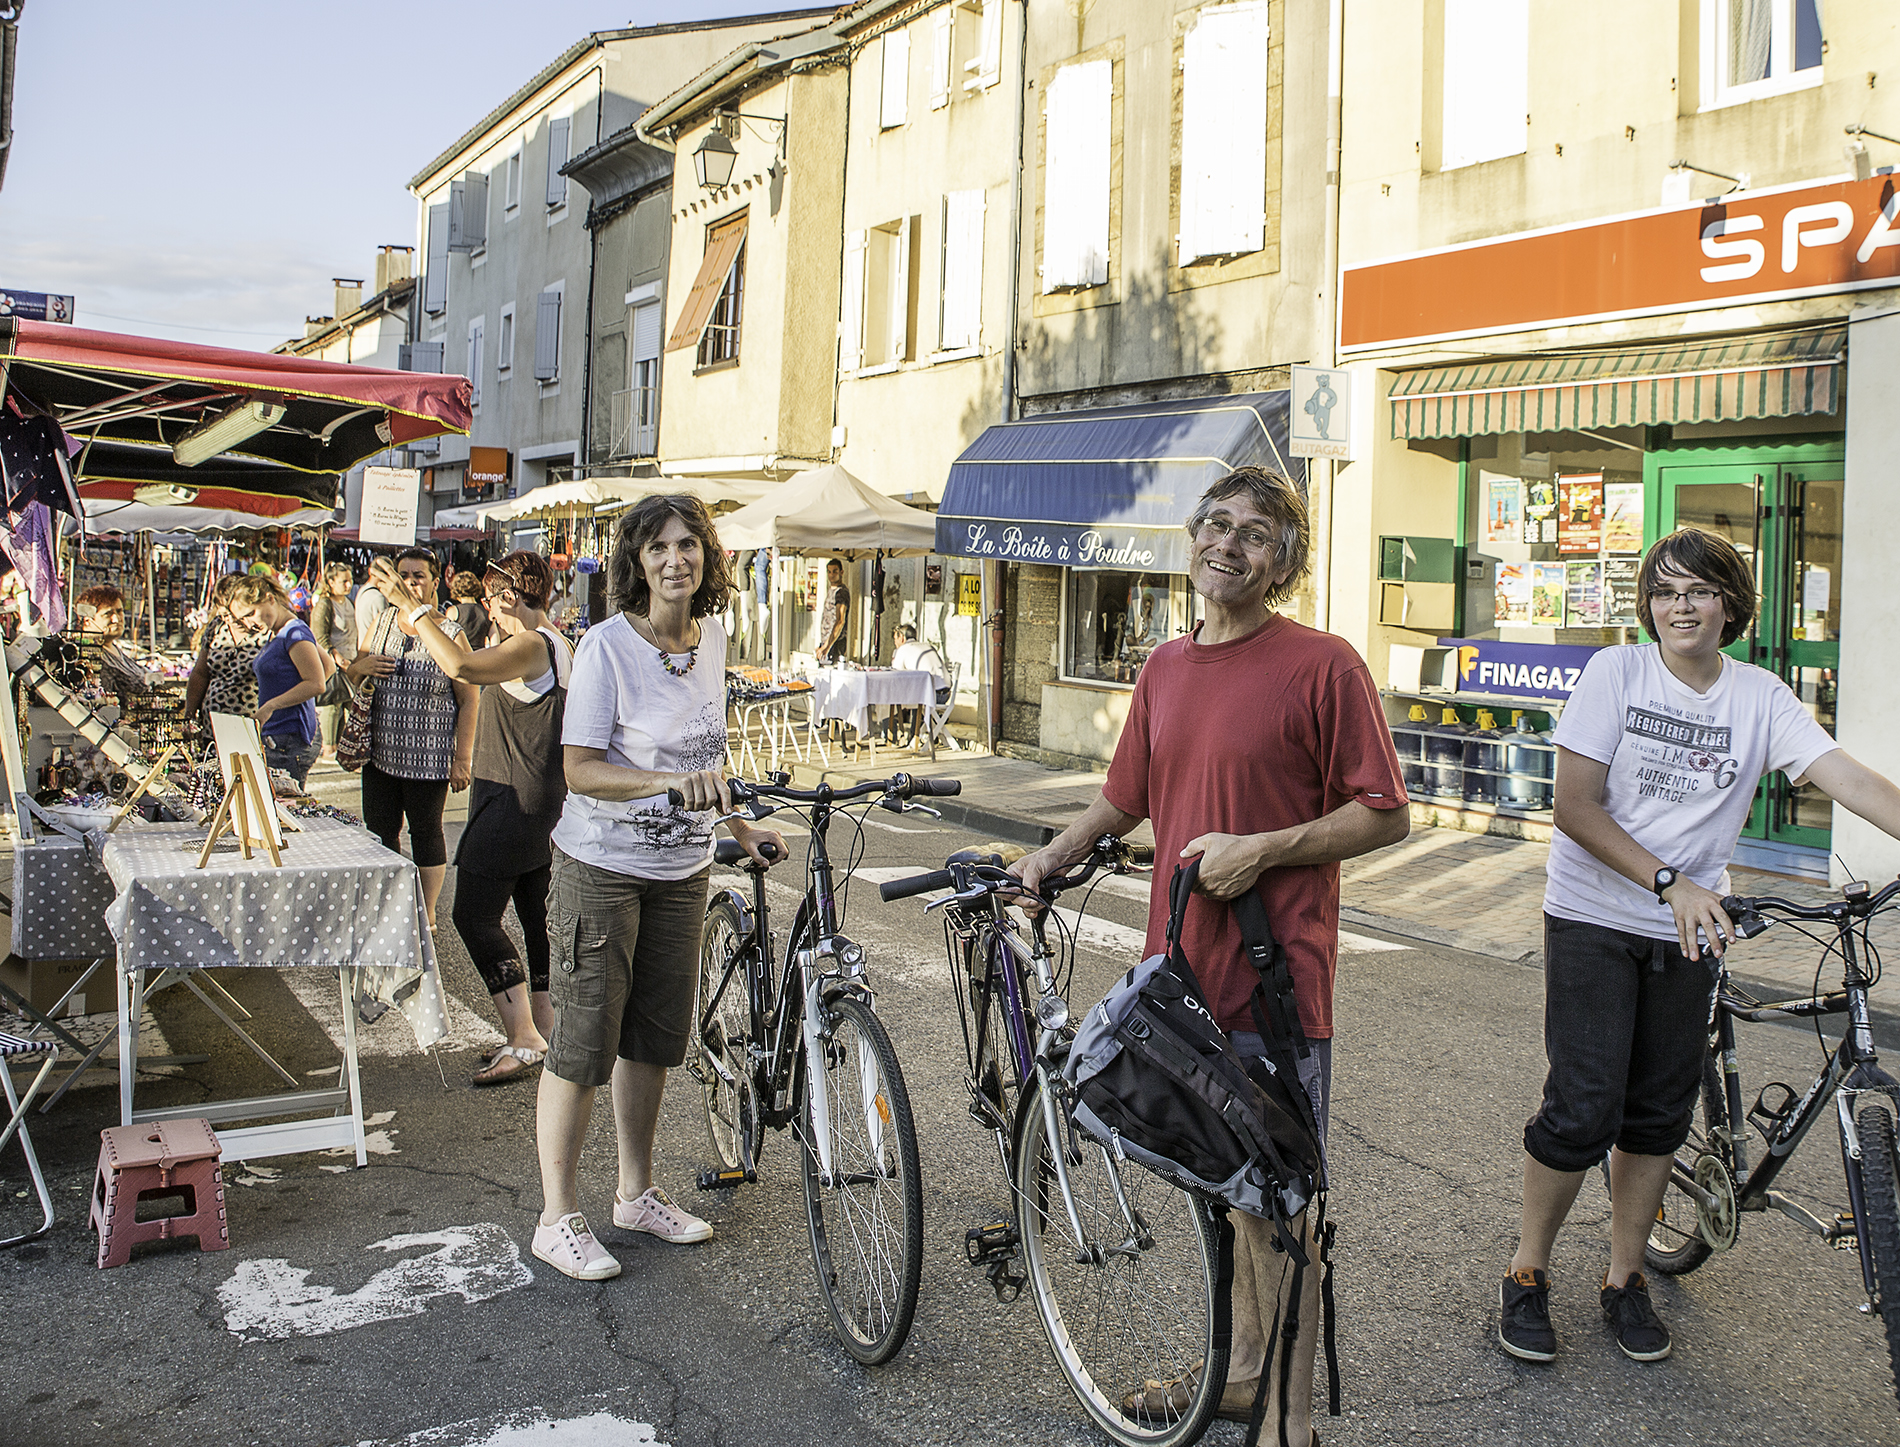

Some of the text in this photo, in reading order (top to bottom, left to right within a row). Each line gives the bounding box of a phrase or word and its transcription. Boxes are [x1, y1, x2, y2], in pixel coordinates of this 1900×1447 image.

[1291, 442, 1347, 456] BUTAGAZ
[472, 472, 504, 483] orange
[965, 524, 1155, 566] La Boîte à Poudre
[964, 580, 969, 594] A
[1479, 661, 1581, 692] FINAGAZ
[1649, 700, 1716, 724] PREMIUM QUALITY
[1626, 711, 1729, 748] REGISTERED LABEL
[1630, 742, 1659, 756] GENUINE
[1635, 766, 1699, 792] AUTHENTIC
[1713, 758, 1739, 790] 6
[1638, 782, 1687, 804] VINTAGE
